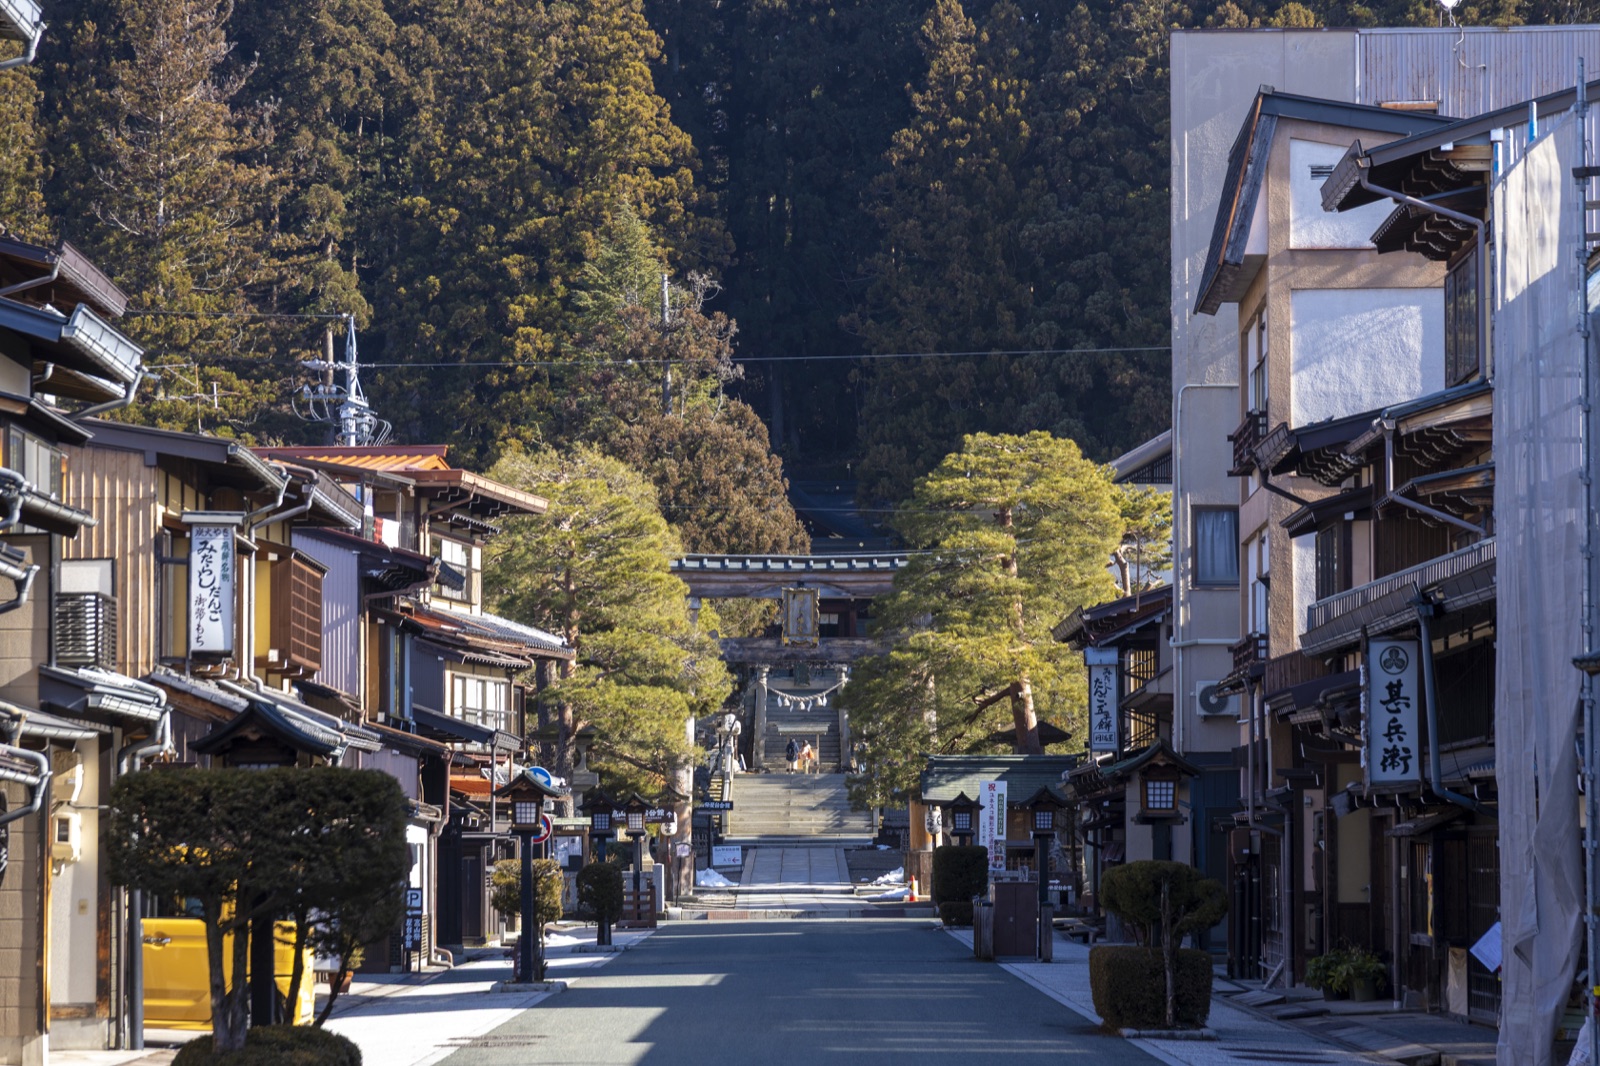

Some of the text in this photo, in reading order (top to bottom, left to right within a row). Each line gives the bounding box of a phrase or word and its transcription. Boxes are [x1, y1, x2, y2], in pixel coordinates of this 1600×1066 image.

[1380, 679, 1412, 775] 甚兵衛
[410, 893, 419, 905] P
